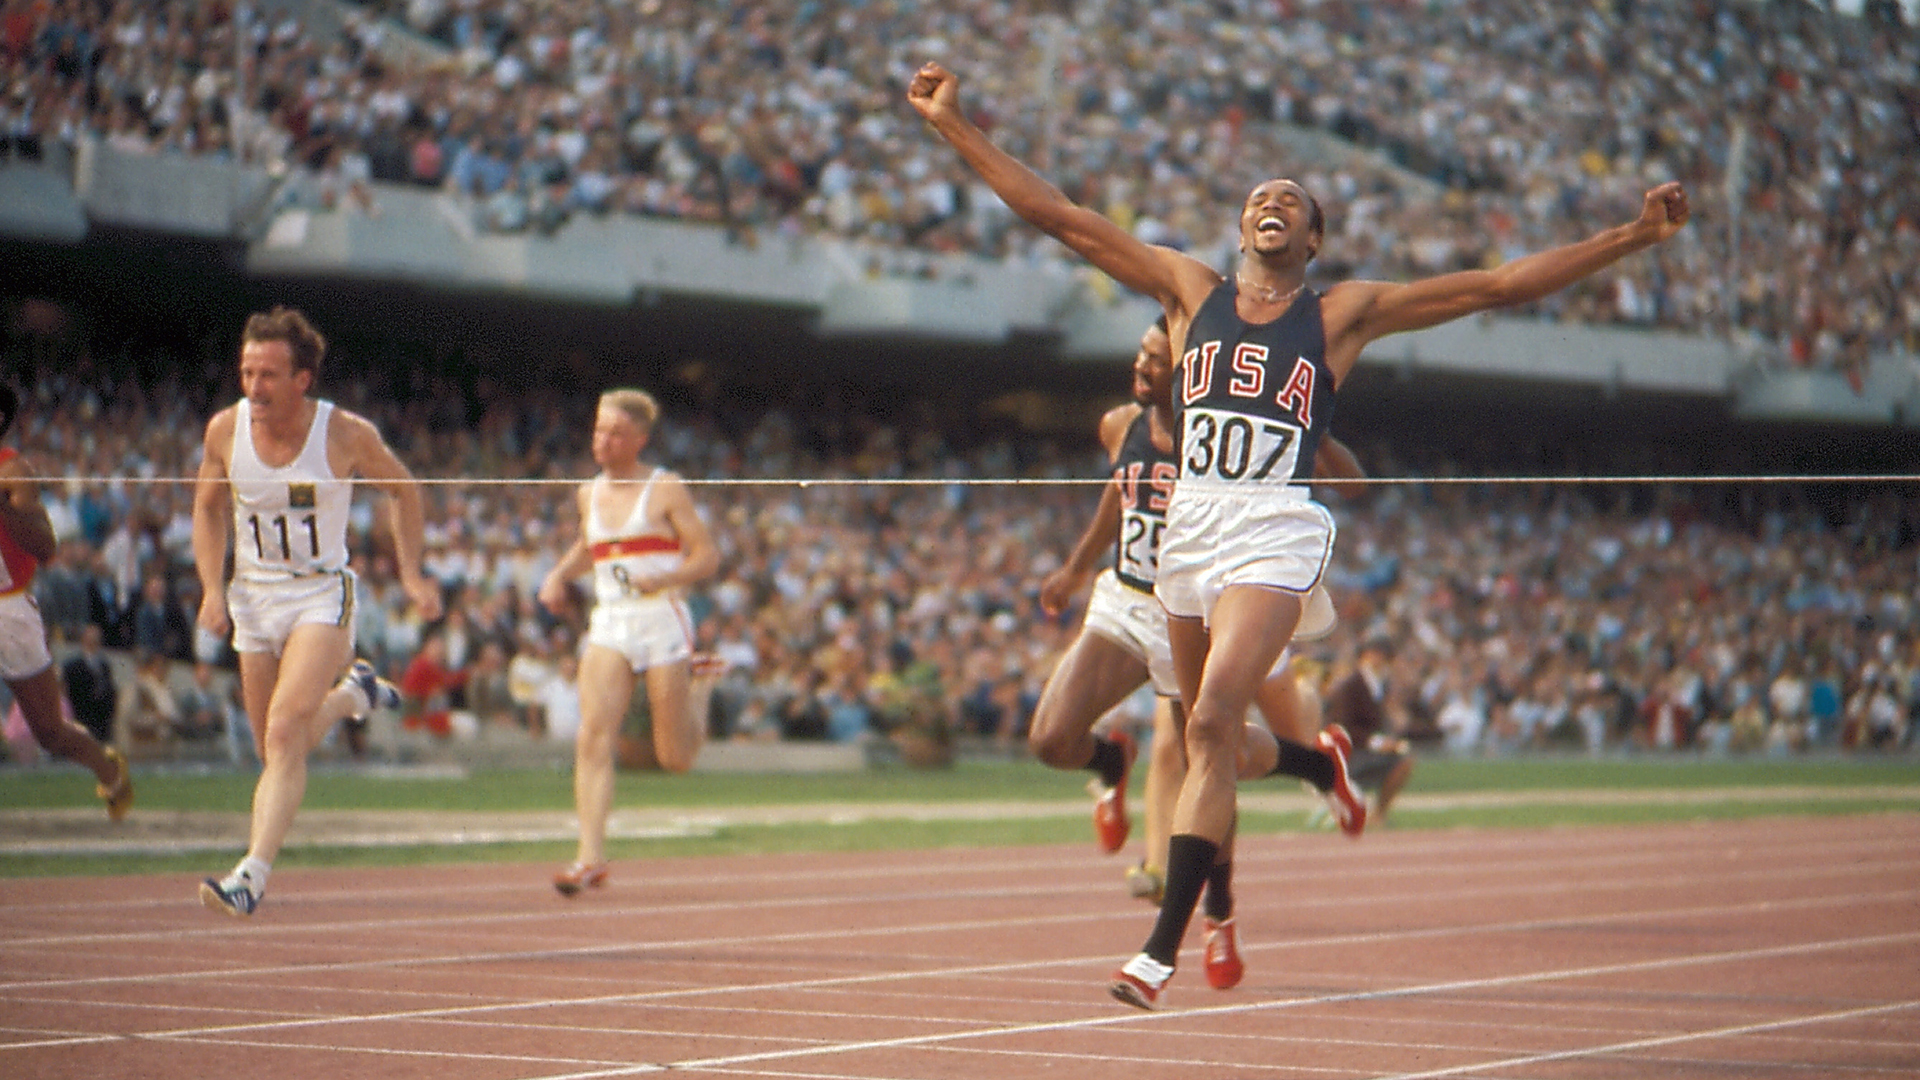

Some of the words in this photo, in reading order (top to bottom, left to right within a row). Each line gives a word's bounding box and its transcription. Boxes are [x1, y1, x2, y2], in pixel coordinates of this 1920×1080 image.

[1183, 341, 1316, 430] USA
[1187, 412, 1296, 480] 307
[1113, 462, 1178, 510] US
[248, 513, 319, 560] 111
